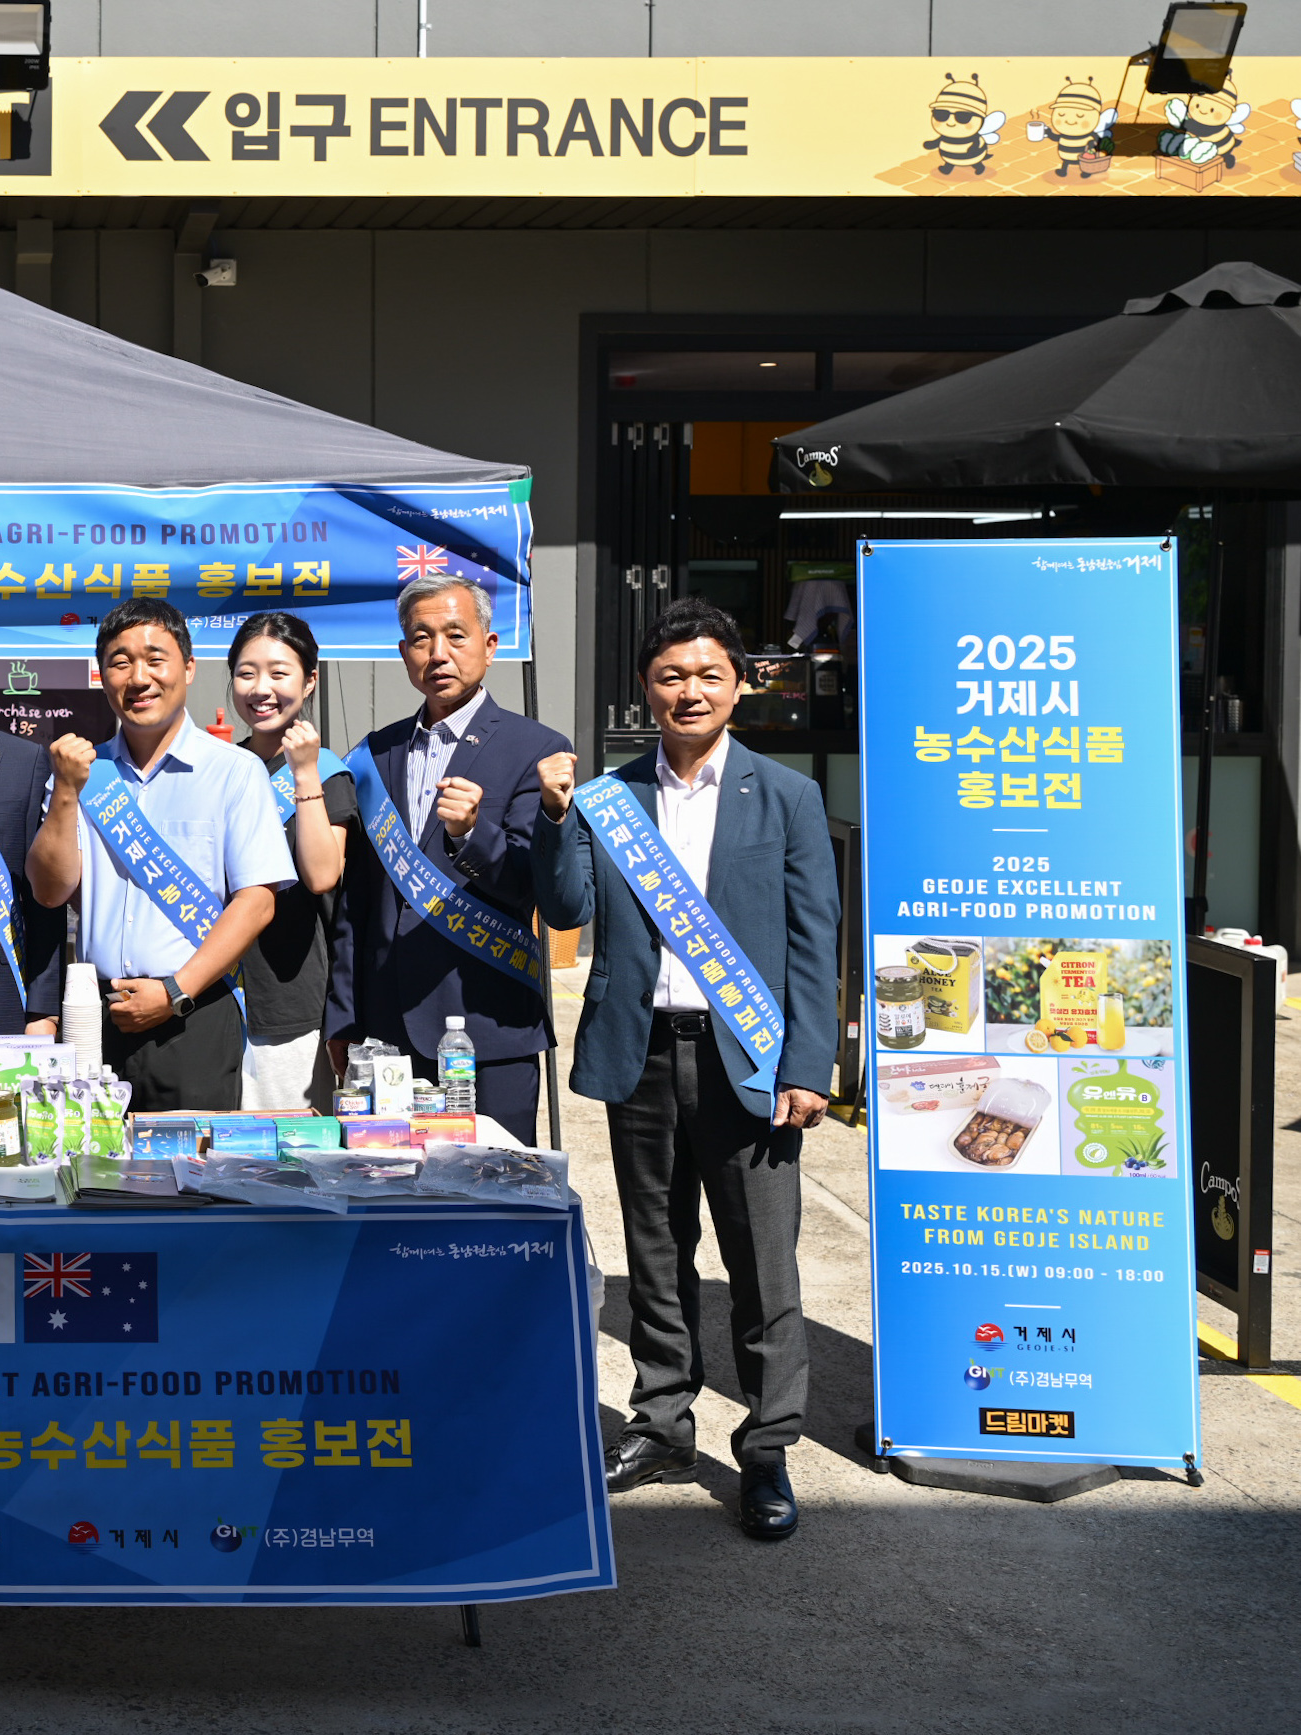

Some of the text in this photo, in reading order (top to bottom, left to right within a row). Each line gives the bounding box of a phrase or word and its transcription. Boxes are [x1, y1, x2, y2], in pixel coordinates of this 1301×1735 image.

[224, 91, 749, 162] 입구 ENTRANCE
[161, 520, 329, 545] PROMOTION
[1122, 554, 1162, 575] 거제
[195, 560, 331, 598] 홍보전
[956, 634, 1077, 671] 2025
[956, 680, 1080, 717] 거제시
[45, 708, 74, 718] over
[10, 721, 37, 736] $35
[913, 725, 1125, 763] 농수산식품
[583, 783, 623, 810] 2025
[957, 770, 1082, 809] 홍보전
[98, 792, 129, 825] 2025
[375, 813, 397, 846] 2025
[110, 819, 163, 885] 거제시
[126, 811, 206, 903] GEOJE EXCELLENT
[992, 856, 1051, 873] 2025
[394, 829, 413, 859] GEOJE
[413, 859, 472, 911] EXCELLENT
[922, 878, 1122, 897] GEOJE EXCELLENT
[383, 838, 425, 899] 거제시
[423, 895, 527, 970] 농수산식품
[897, 900, 1156, 921] AGRI-FOOD PROMOTION
[595, 807, 776, 1055] 거제시 농수산식품 홍보전
[617, 798, 784, 1039] GEOJE EXCELLENT AGRI-FOOD PROMOTION
[1061, 961, 1095, 969] CITRON
[919, 976, 956, 987] HONEY
[1061, 976, 1096, 988] TEA
[900, 1203, 1165, 1228] TASTE KOREA'S NATURE
[507, 1241, 554, 1262] 거제
[924, 1228, 1149, 1251] FROM GEOJE ISLAND
[901, 1260, 1038, 1279] 2025.10.15.(W)
[1044, 1266, 1095, 1281] 09:00
[1115, 1269, 1164, 1283] 18:00
[1017, 1344, 1075, 1352] GEOJE-SI
[31, 1370, 201, 1397] AGRI-FOOD
[215, 1369, 401, 1396] PROMOTION
[1009, 1371, 1092, 1389] (주)경남무역
[985, 1411, 1069, 1435] 드림마켓
[259, 1417, 413, 1469] 홍보전
[264, 1527, 374, 1549] (주)경남무역
